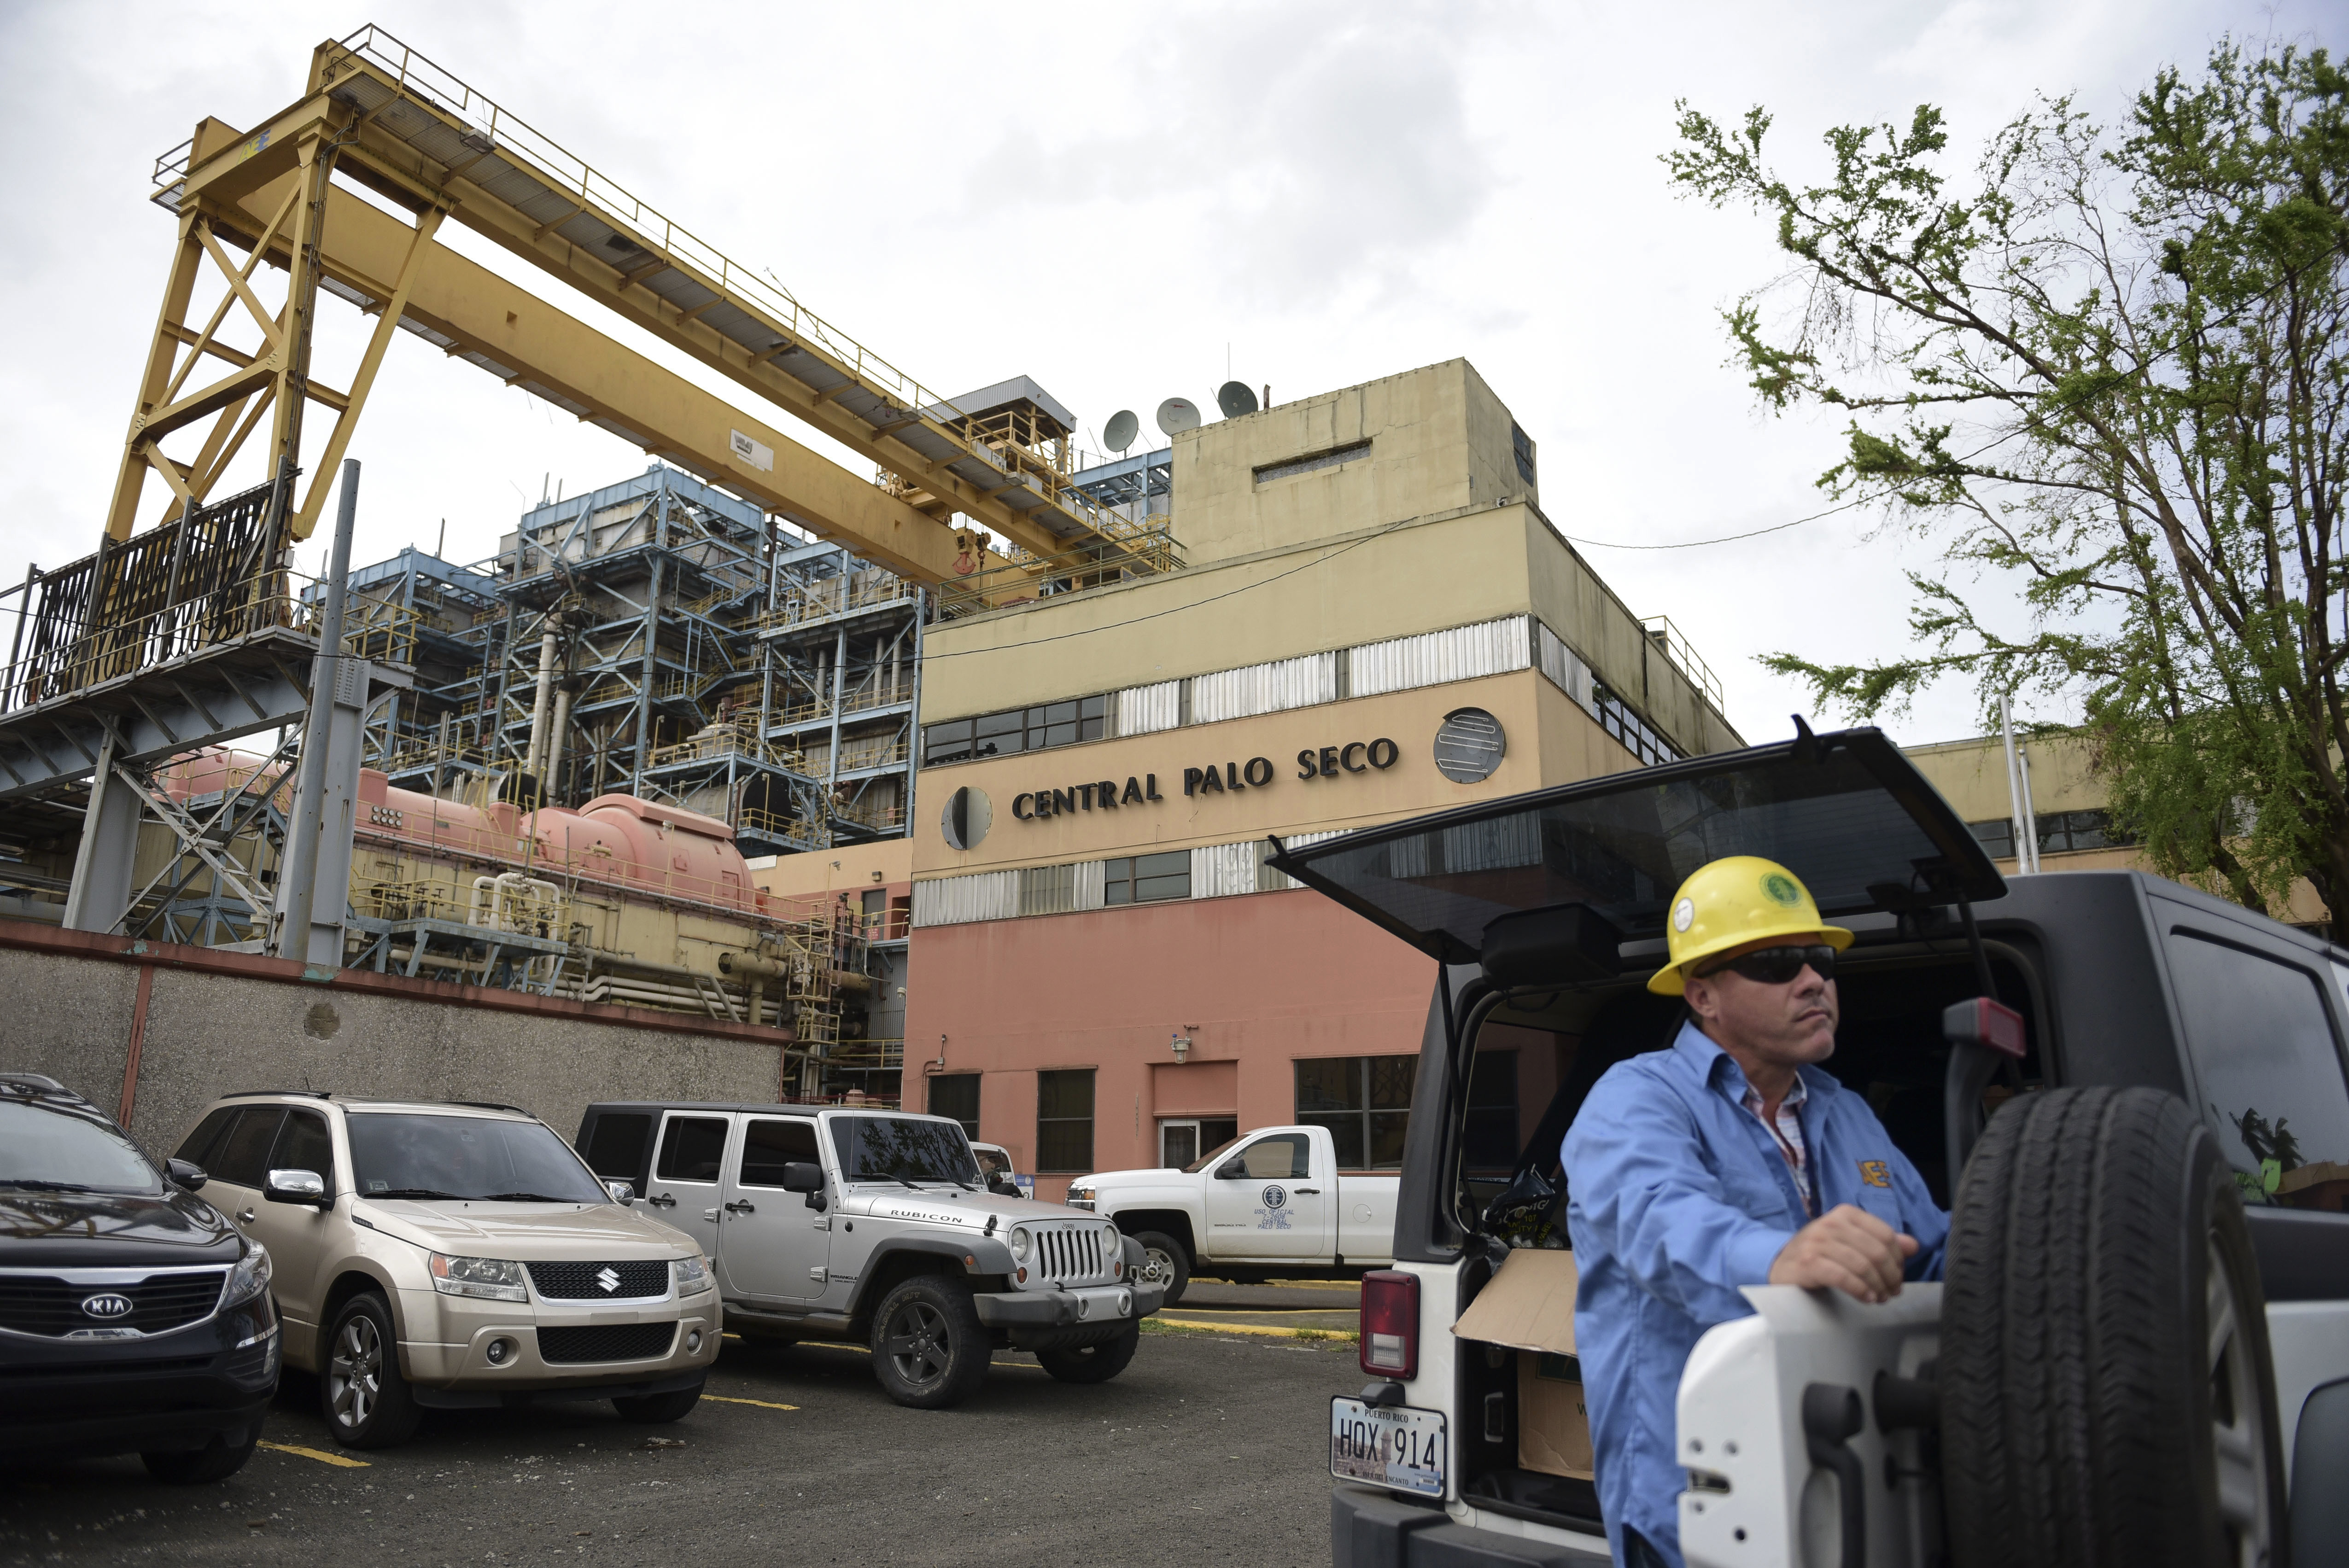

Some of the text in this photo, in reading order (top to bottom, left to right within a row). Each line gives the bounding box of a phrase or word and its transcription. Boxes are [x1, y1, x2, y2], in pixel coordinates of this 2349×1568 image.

[1012, 738, 1399, 820] CENTRAL PALO SECO
[891, 1210, 962, 1223] RUBICON
[1061, 1221, 1075, 1230] Jeep
[92, 1300, 124, 1313] KIA
[1365, 1409, 1408, 1423] PUERTO RICO
[1340, 1418, 1435, 1472] HQX 914
[1385, 1475, 1408, 1486] ENCANTO
